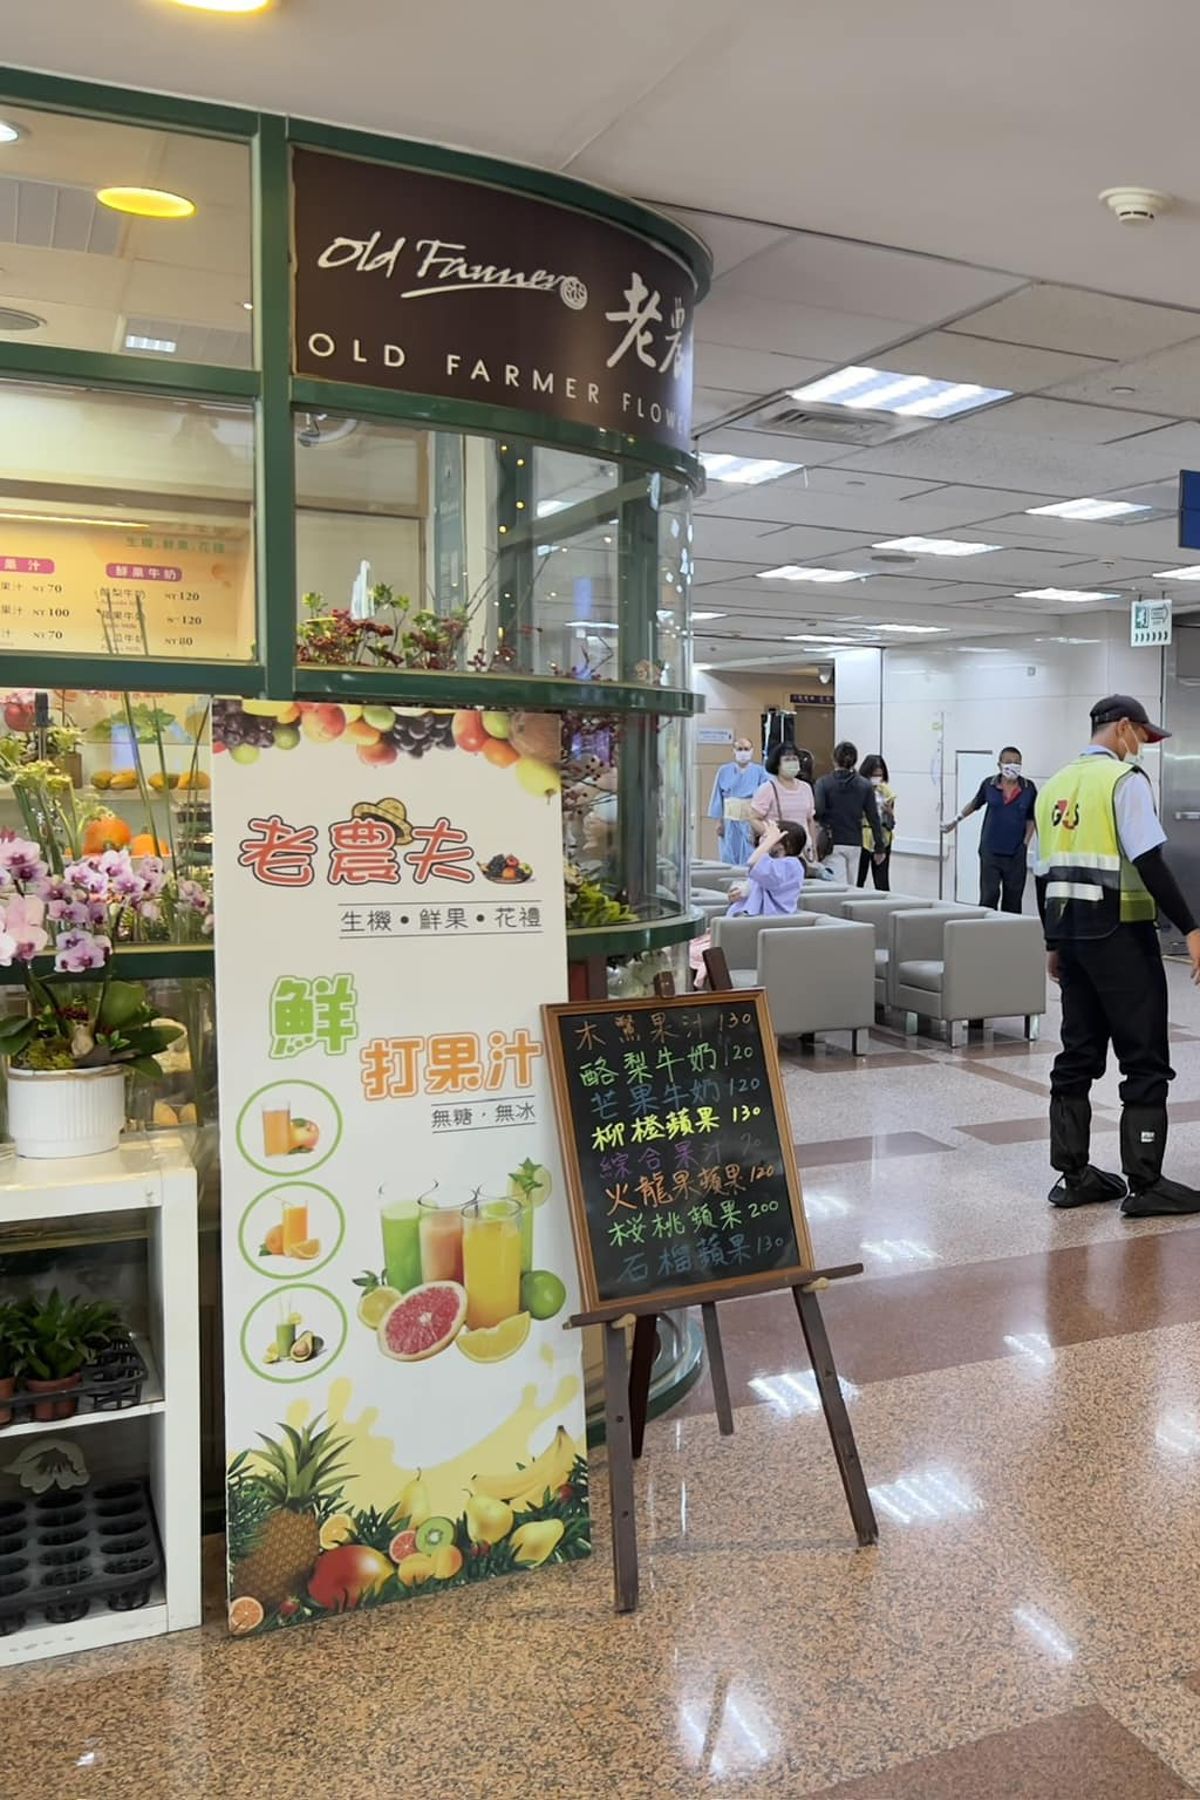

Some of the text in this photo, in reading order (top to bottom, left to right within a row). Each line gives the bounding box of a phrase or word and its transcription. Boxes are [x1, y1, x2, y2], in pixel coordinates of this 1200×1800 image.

[317, 231, 406, 278] Old
[308, 333, 405, 367] OLD
[446, 355, 600, 403] FARMER
[238, 815, 476, 888] 老農夫
[269, 973, 359, 1061] 鮮
[719, 1012, 751, 1033] 130
[360, 1029, 545, 1101] 打果汁
[579, 1042, 754, 1087] 酪梨牛奶 120
[590, 1078, 761, 1120] 芒果牛奶 120
[591, 1105, 761, 1152] 柳橙蘋果 130
[748, 1200, 779, 1218] 200
